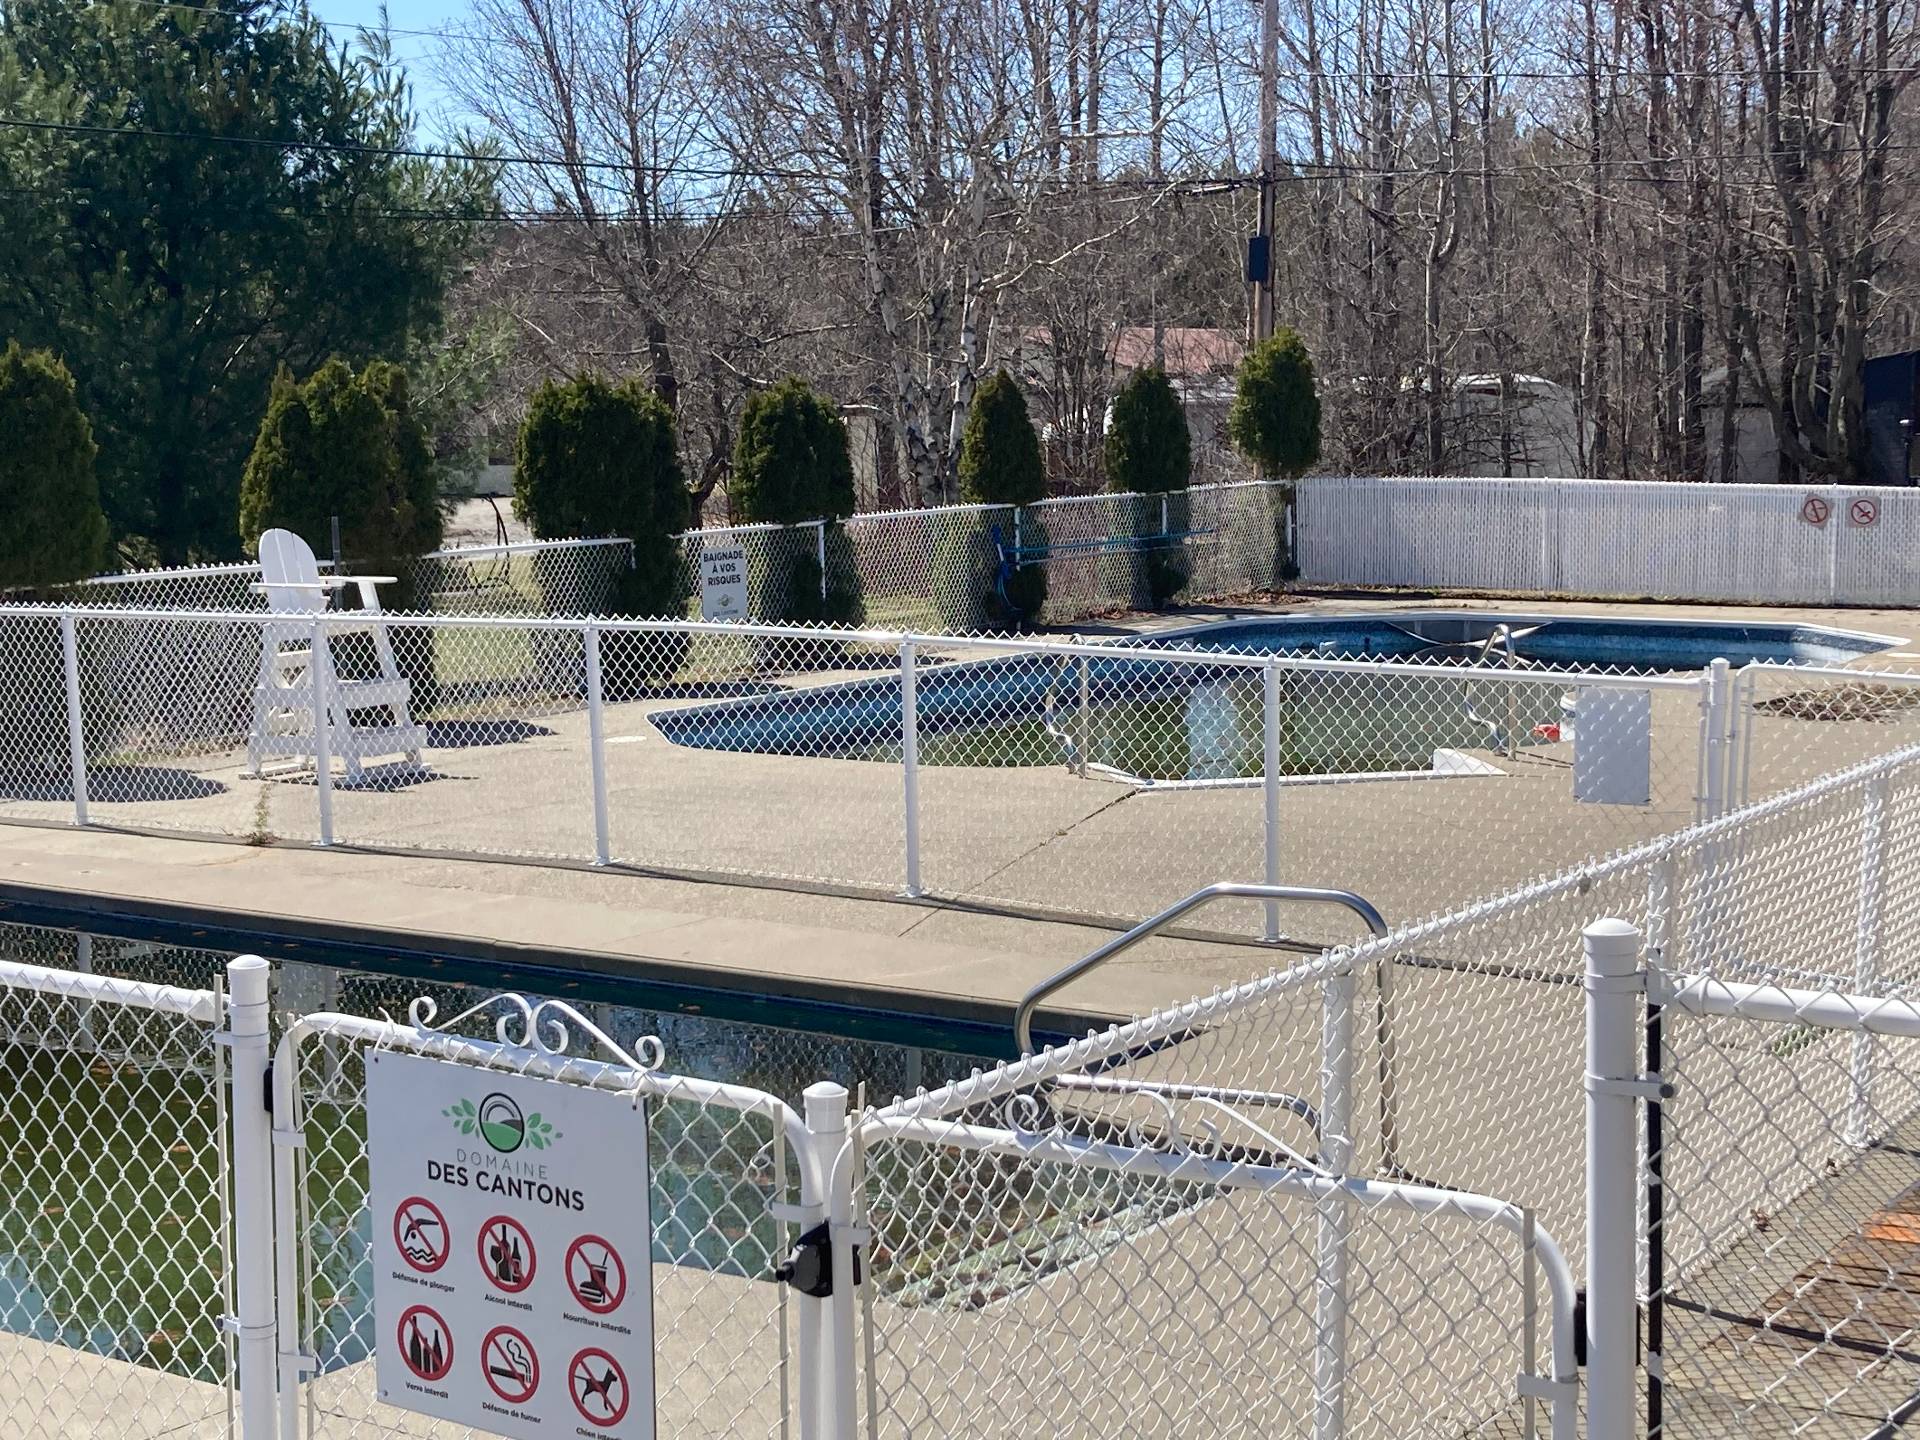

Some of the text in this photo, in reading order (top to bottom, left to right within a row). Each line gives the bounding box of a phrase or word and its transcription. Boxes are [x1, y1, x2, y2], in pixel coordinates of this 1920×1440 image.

[703, 550, 744, 562] BAIGNADE
[712, 562, 736, 573] À VOS
[708, 574, 741, 586] RISQUES
[456, 1148, 548, 1180] DOMAINE
[427, 1160, 585, 1212] DES CANTONS
[430, 1281, 455, 1293] plonger
[485, 1293, 533, 1311] Alcool interdit
[563, 1312, 632, 1335] Nourriture interdite
[405, 1381, 449, 1399] Verre interdit
[510, 1410, 519, 1418] de
[520, 1412, 541, 1424] fumer
[576, 1427, 596, 1438] Chien
